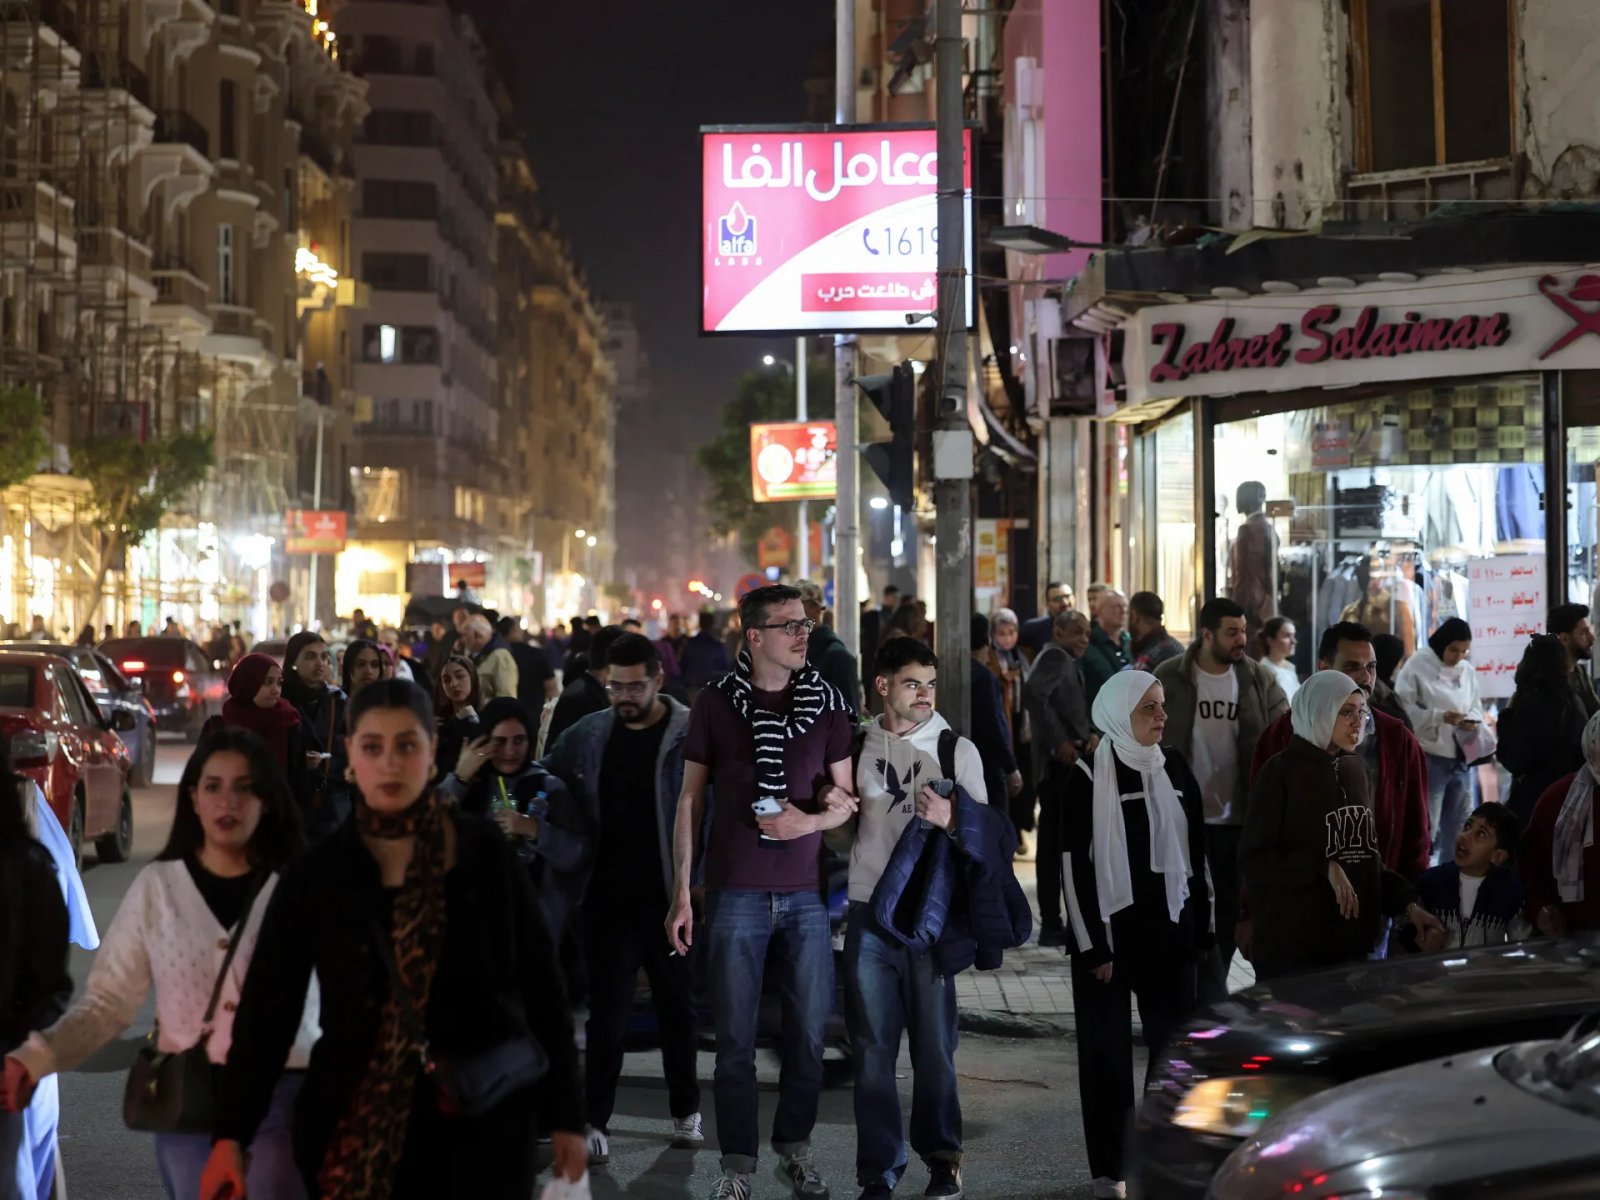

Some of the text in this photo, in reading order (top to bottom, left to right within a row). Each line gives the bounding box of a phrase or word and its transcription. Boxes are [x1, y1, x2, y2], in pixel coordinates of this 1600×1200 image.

[722, 140, 803, 188] الفا
[721, 235, 754, 253] alfa
[714, 256, 763, 266] LABS
[817, 285, 856, 303] حرب
[857, 282, 910, 298] طلعت
[1150, 304, 1511, 383] Zahret Solaiman
[1199, 700, 1239, 721] OCU
[902, 804, 912, 813] AE
